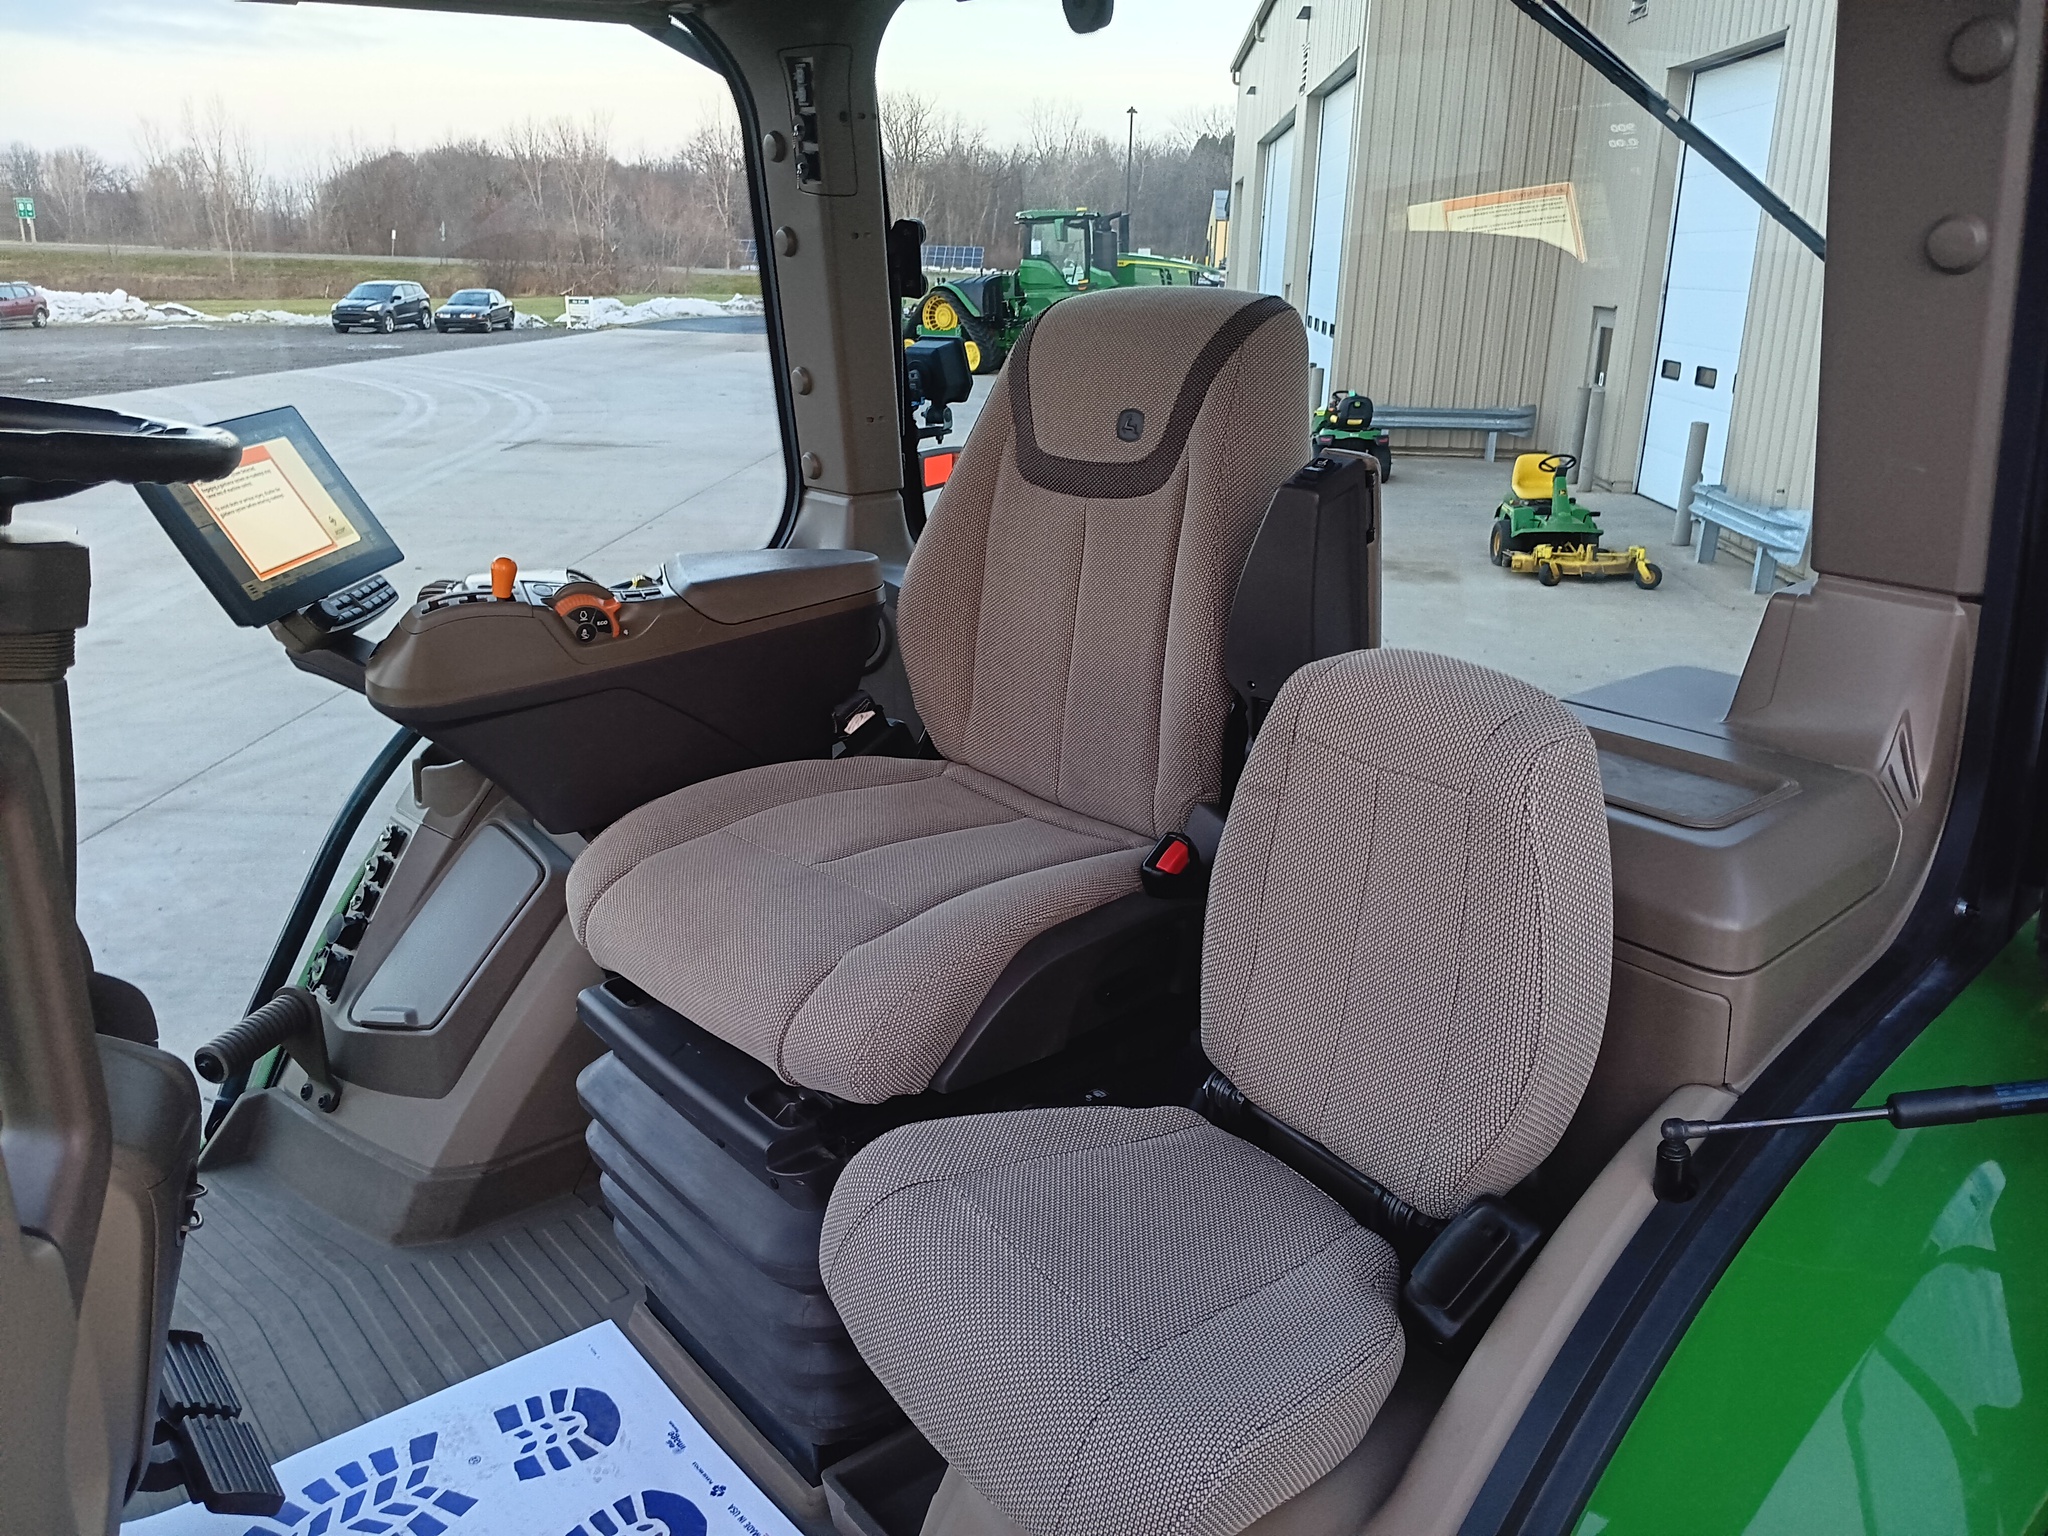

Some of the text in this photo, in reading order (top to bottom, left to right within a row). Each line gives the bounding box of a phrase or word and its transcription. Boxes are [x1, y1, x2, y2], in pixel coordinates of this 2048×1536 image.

[727, 1503, 762, 1536] MADE IN USA
